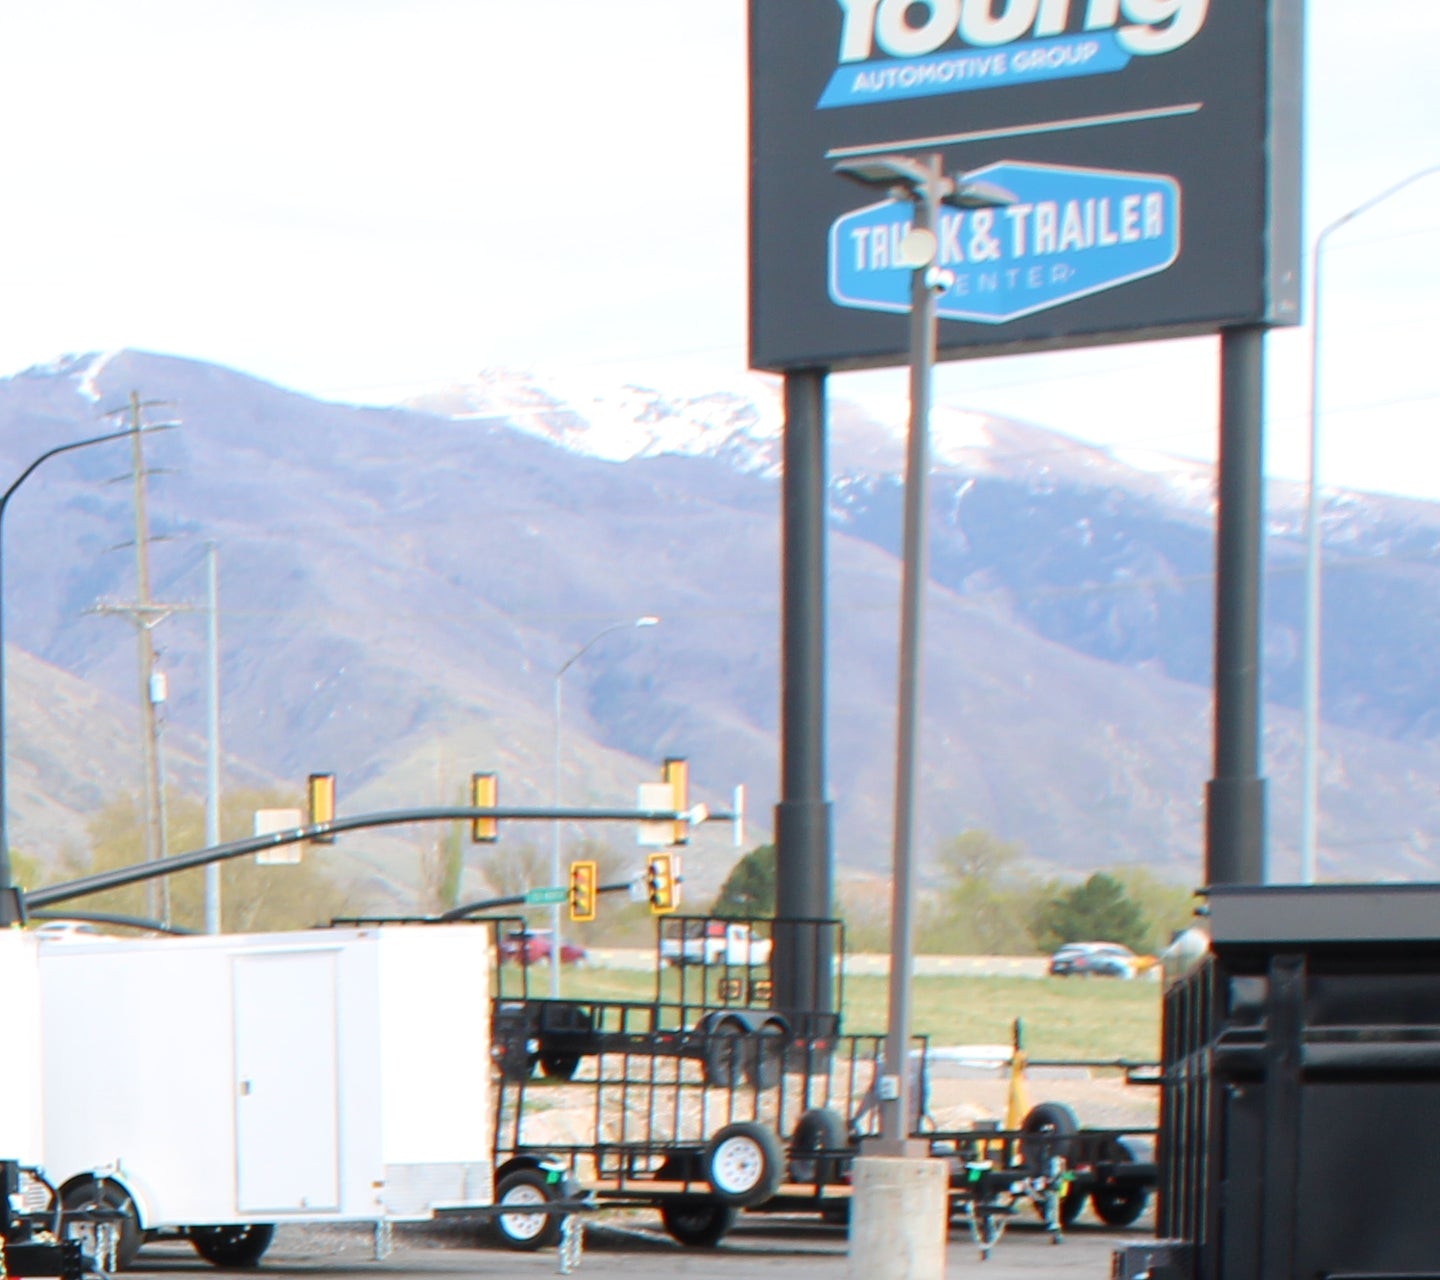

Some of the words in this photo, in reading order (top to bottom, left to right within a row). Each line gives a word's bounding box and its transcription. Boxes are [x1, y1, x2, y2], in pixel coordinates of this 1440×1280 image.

[853, 56, 1007, 92] AUTOMOTIVE
[1013, 43, 1099, 71] GROUP
[851, 213, 965, 271] TRUK
[969, 207, 1002, 262] &
[1005, 191, 1166, 258] TRAILER
[950, 262, 1069, 298] ENTER
